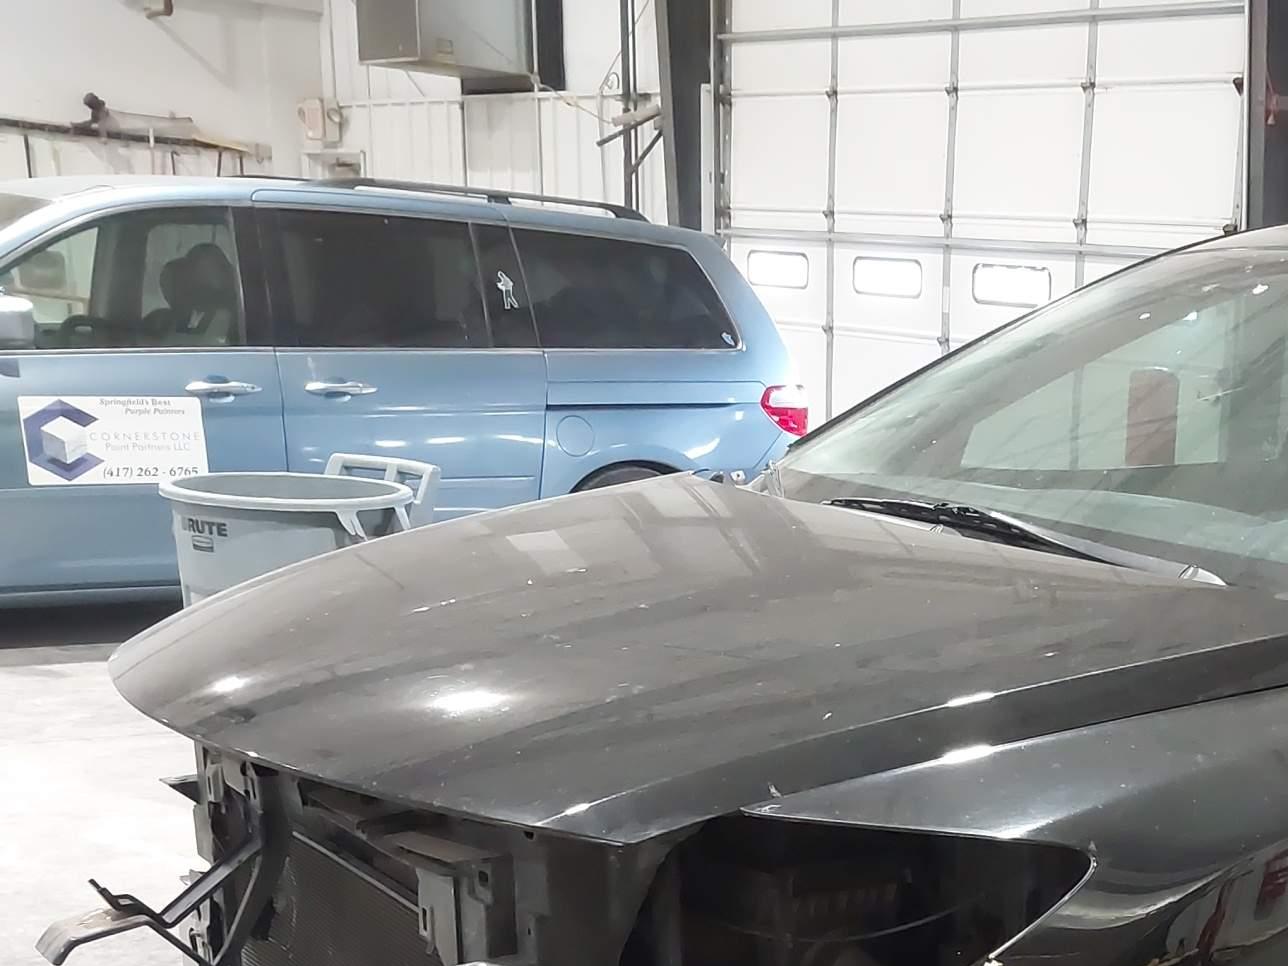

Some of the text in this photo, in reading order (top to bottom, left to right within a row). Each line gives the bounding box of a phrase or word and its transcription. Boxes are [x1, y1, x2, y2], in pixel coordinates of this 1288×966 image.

[99, 398, 171, 407] Springfield's Best
[89, 432, 201, 442] CORNERSTONE
[174, 442, 191, 451] LLC
[103, 466, 133, 480] (417)
[136, 466, 158, 477] 262
[169, 466, 199, 477] 6765
